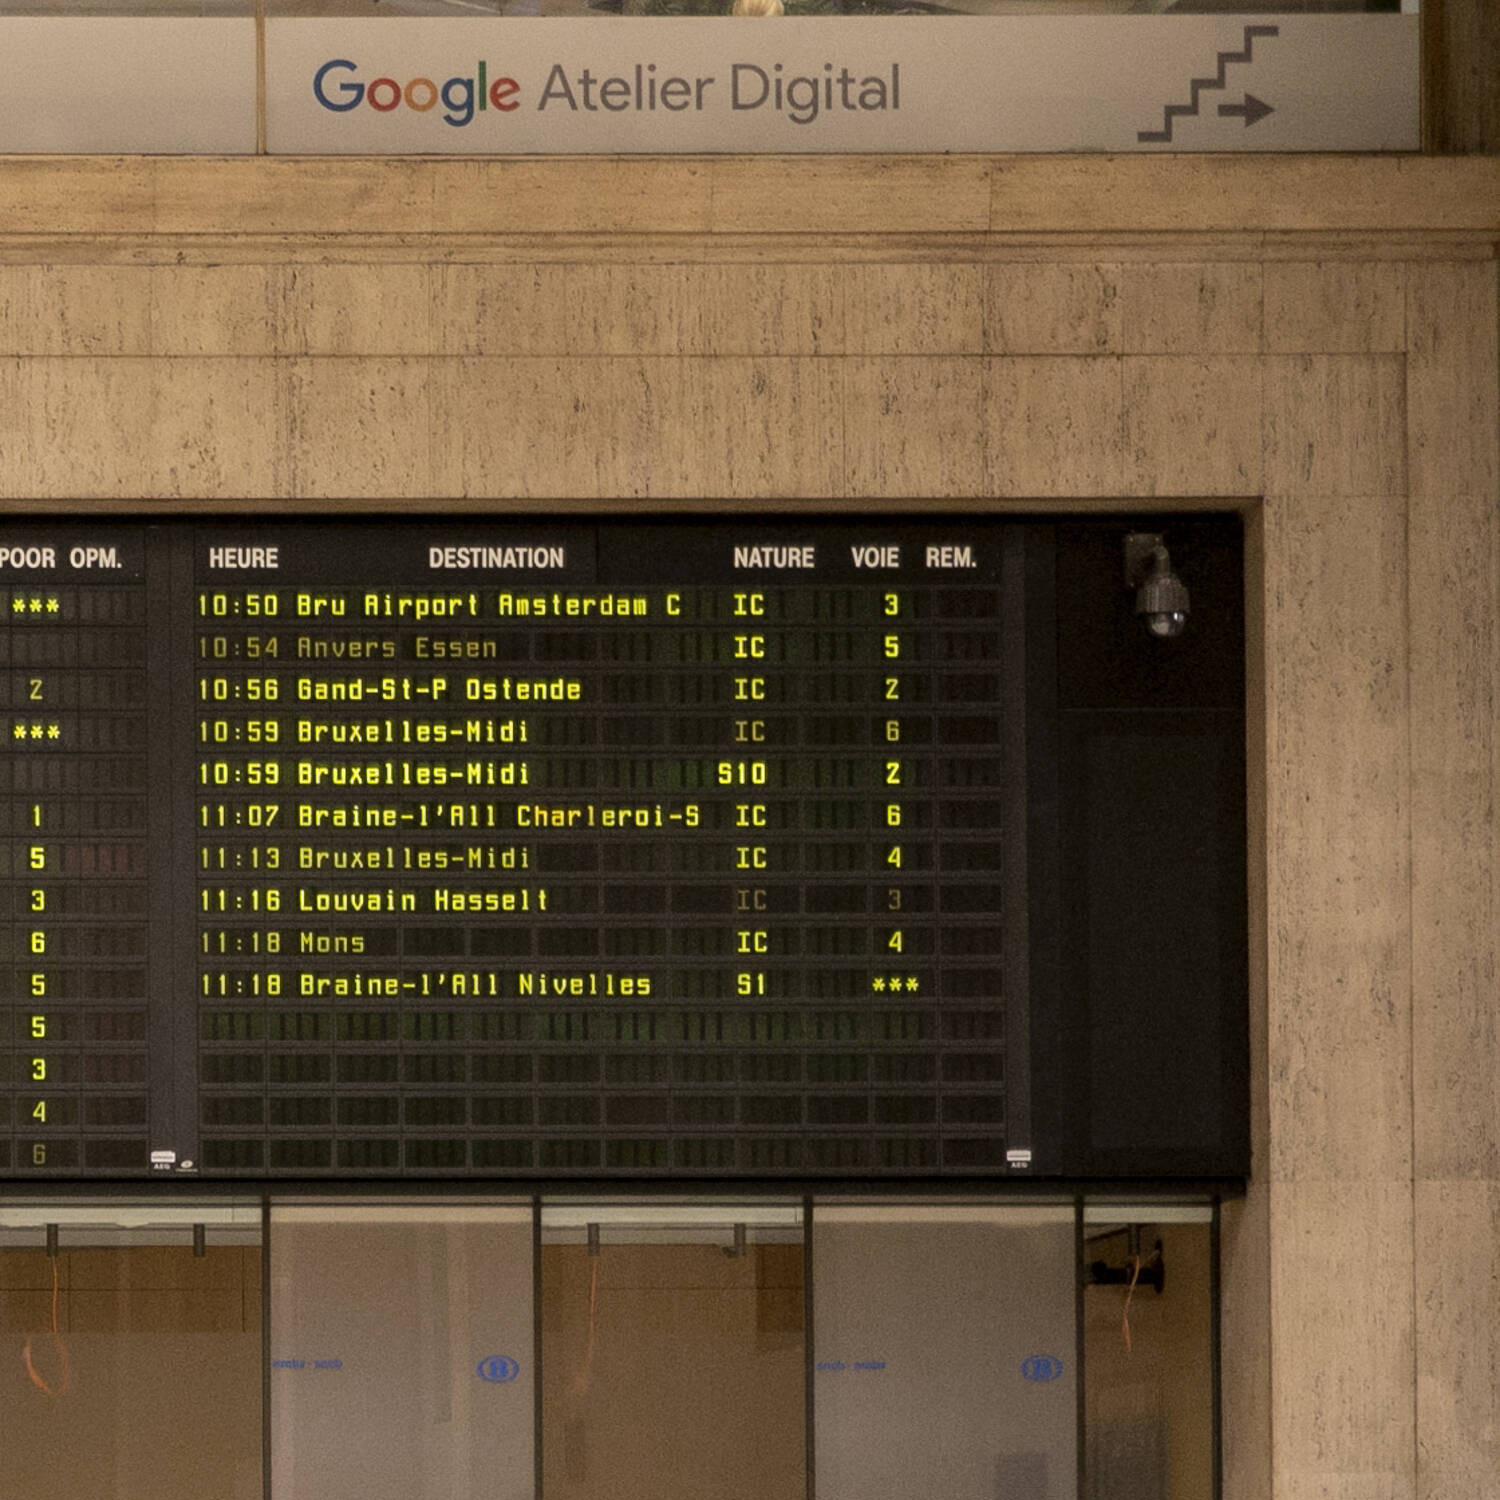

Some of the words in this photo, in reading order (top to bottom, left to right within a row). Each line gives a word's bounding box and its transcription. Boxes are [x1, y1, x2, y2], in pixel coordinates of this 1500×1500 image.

[313, 59, 521, 128] Google
[537, 63, 715, 112] Atelier
[731, 62, 900, 125] Digital
[69, 547, 122, 569] OPM.
[209, 547, 279, 569] HEURE
[429, 546, 564, 569] DESTINATION
[734, 546, 815, 569] NATURE
[851, 546, 900, 569] VOIE
[926, 546, 977, 568] REM.
[27, 678, 43, 701] 2
[199, 677, 279, 701] 10:56
[297, 676, 447, 701] Gand-St-P
[465, 677, 581, 701] Ostende
[734, 676, 765, 701] IC
[884, 676, 899, 701] 2
[200, 760, 280, 786] 10:59
[297, 760, 528, 786] Bruxelles-Midi
[717, 761, 766, 785] S10
[885, 760, 900, 785] 2
[28, 845, 45, 870] 5
